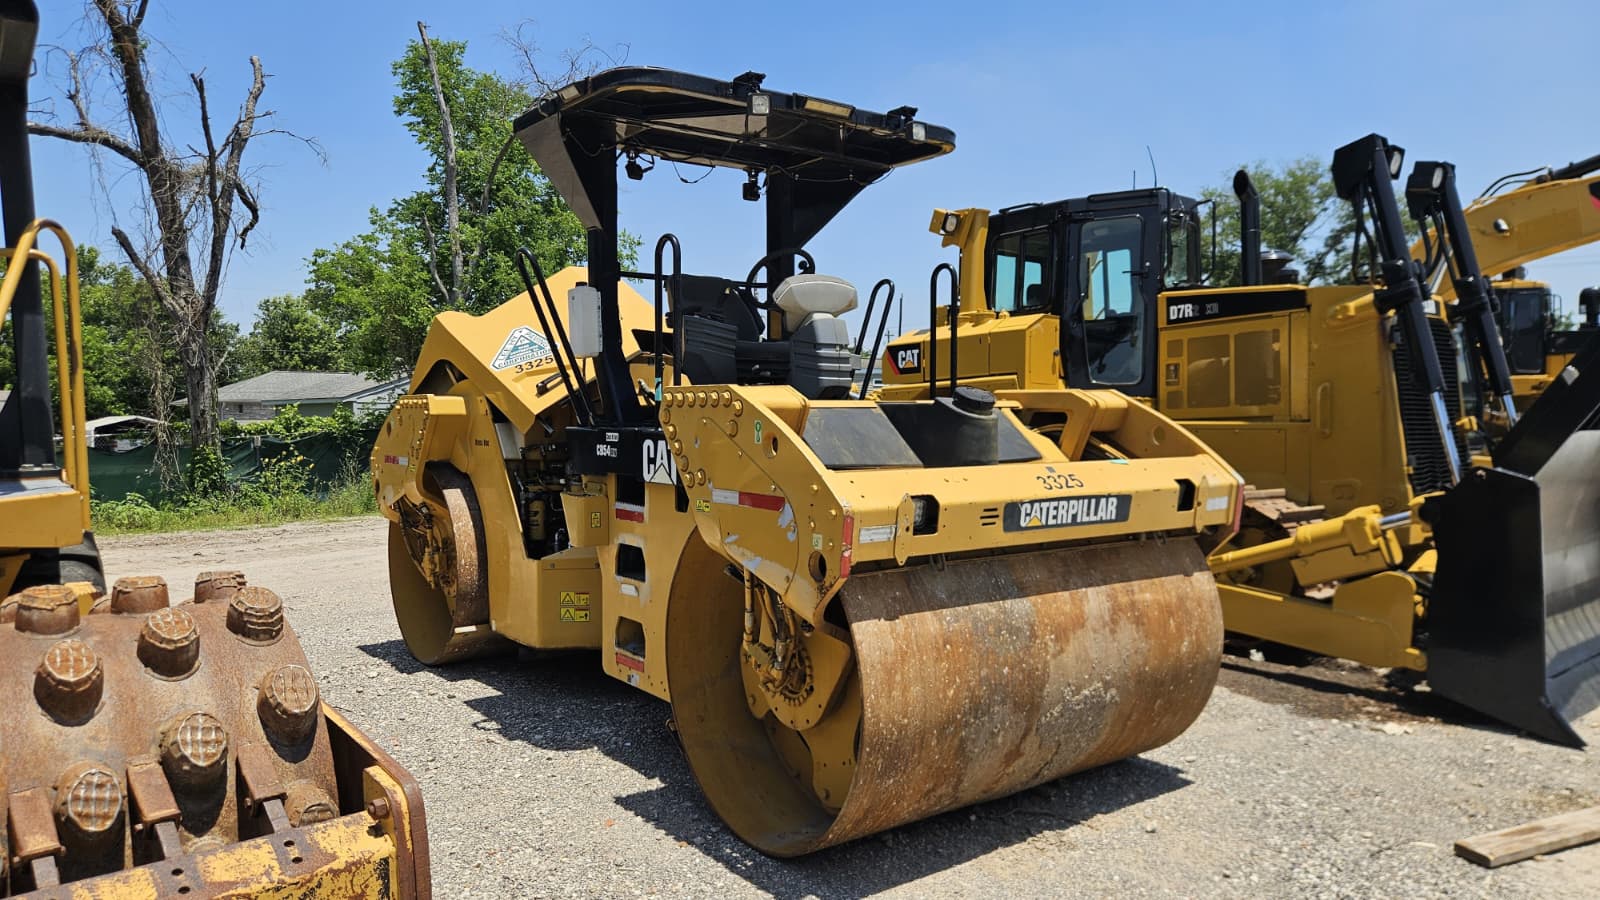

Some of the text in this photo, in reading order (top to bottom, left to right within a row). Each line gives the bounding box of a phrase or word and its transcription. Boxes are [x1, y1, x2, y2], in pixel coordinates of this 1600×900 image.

[515, 355, 554, 373] 3325
[898, 349, 919, 368] CAT
[1036, 473, 1084, 490] 3325
[1019, 497, 1118, 528] CATERPILLAR
